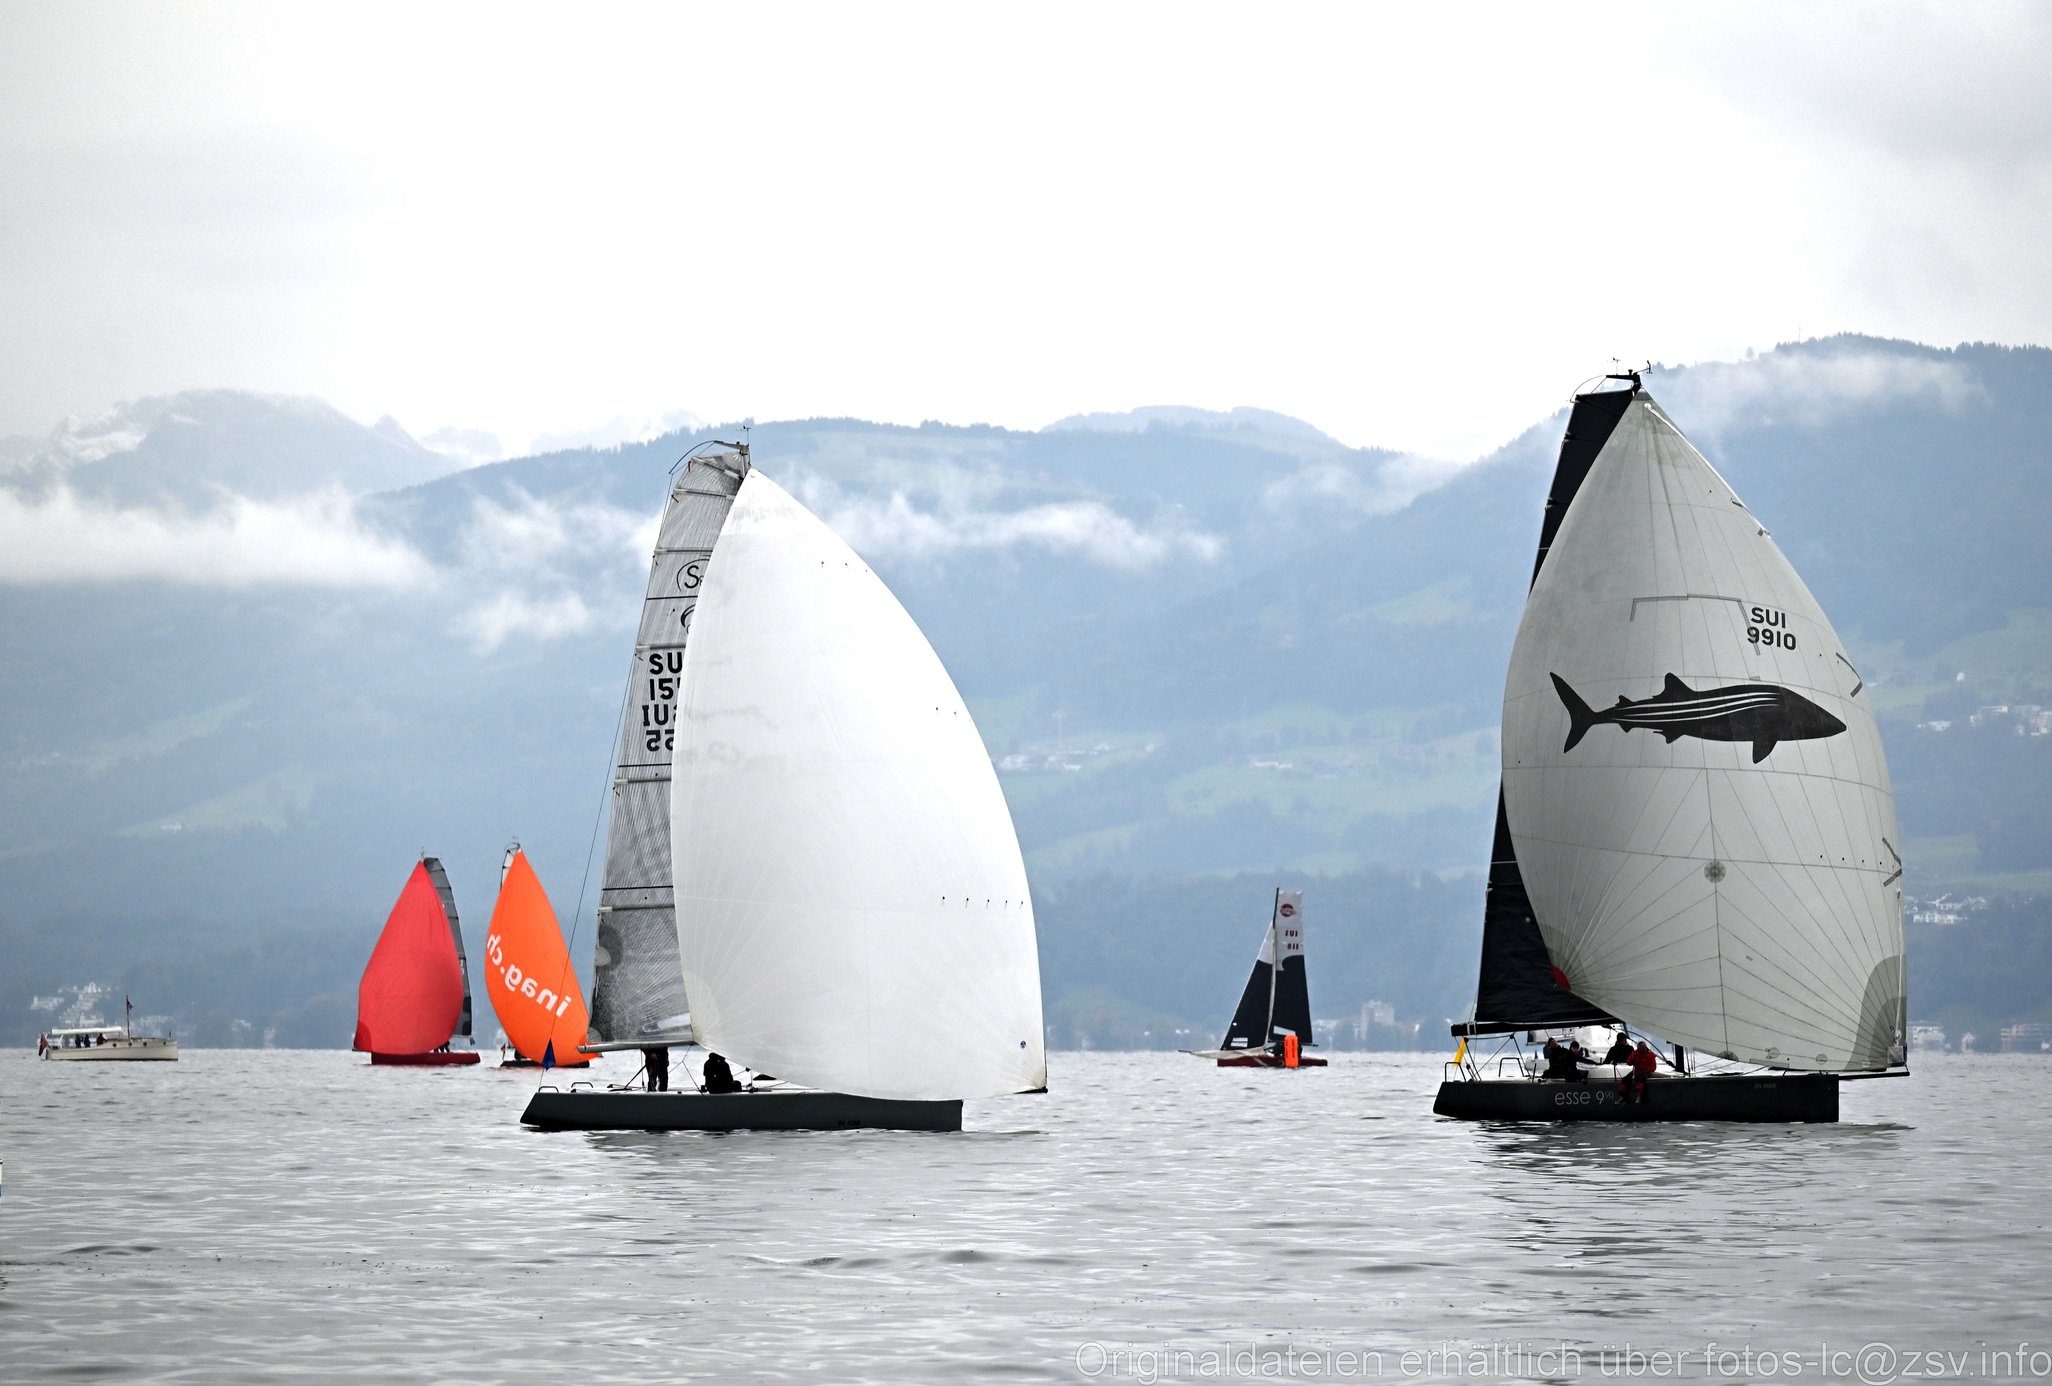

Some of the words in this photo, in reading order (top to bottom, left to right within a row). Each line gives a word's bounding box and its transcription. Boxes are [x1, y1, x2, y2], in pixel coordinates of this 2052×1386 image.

[1750, 606, 1786, 629] SUI
[1746, 626, 1797, 651] 9910
[649, 677, 681, 701] 15
[1554, 1091, 1591, 1106] esse
